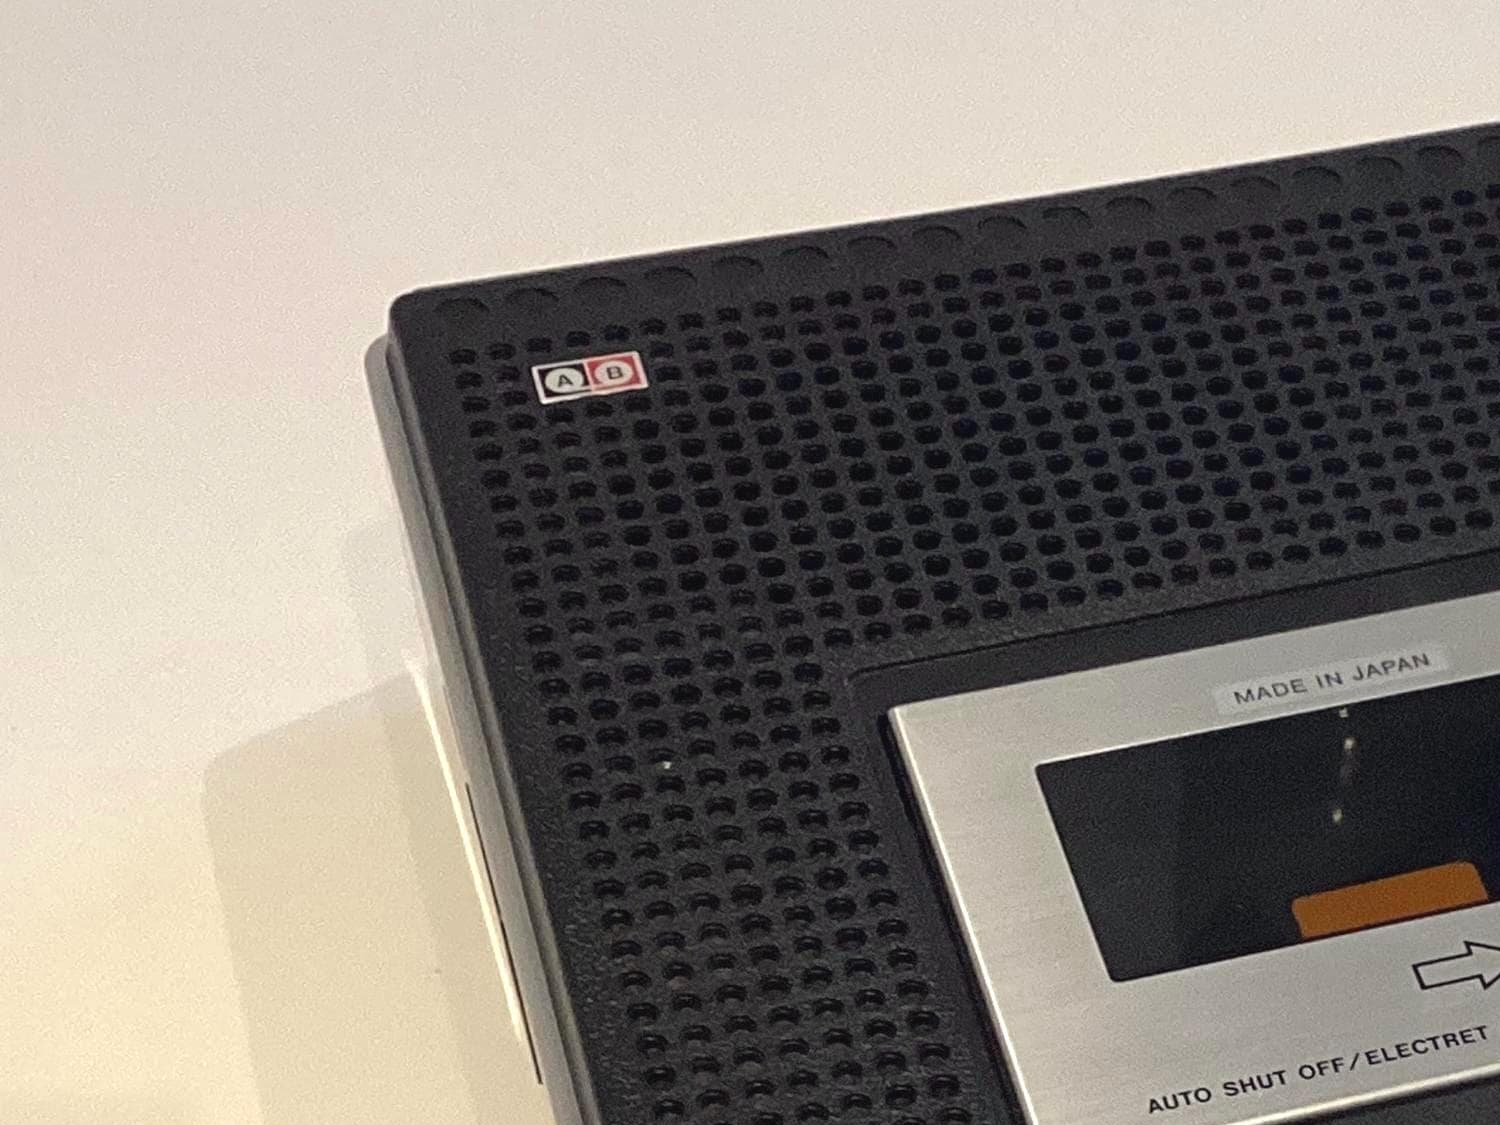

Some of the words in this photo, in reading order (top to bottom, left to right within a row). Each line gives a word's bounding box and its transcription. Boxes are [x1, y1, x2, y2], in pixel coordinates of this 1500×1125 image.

[557, 374, 574, 388] A
[606, 366, 625, 381] B
[1234, 678, 1308, 705] MADE
[1316, 672, 1344, 689] IN
[1353, 653, 1430, 682] JAPAN
[1148, 1087, 1212, 1115] AUTO
[1223, 1070, 1287, 1097] SHUT
